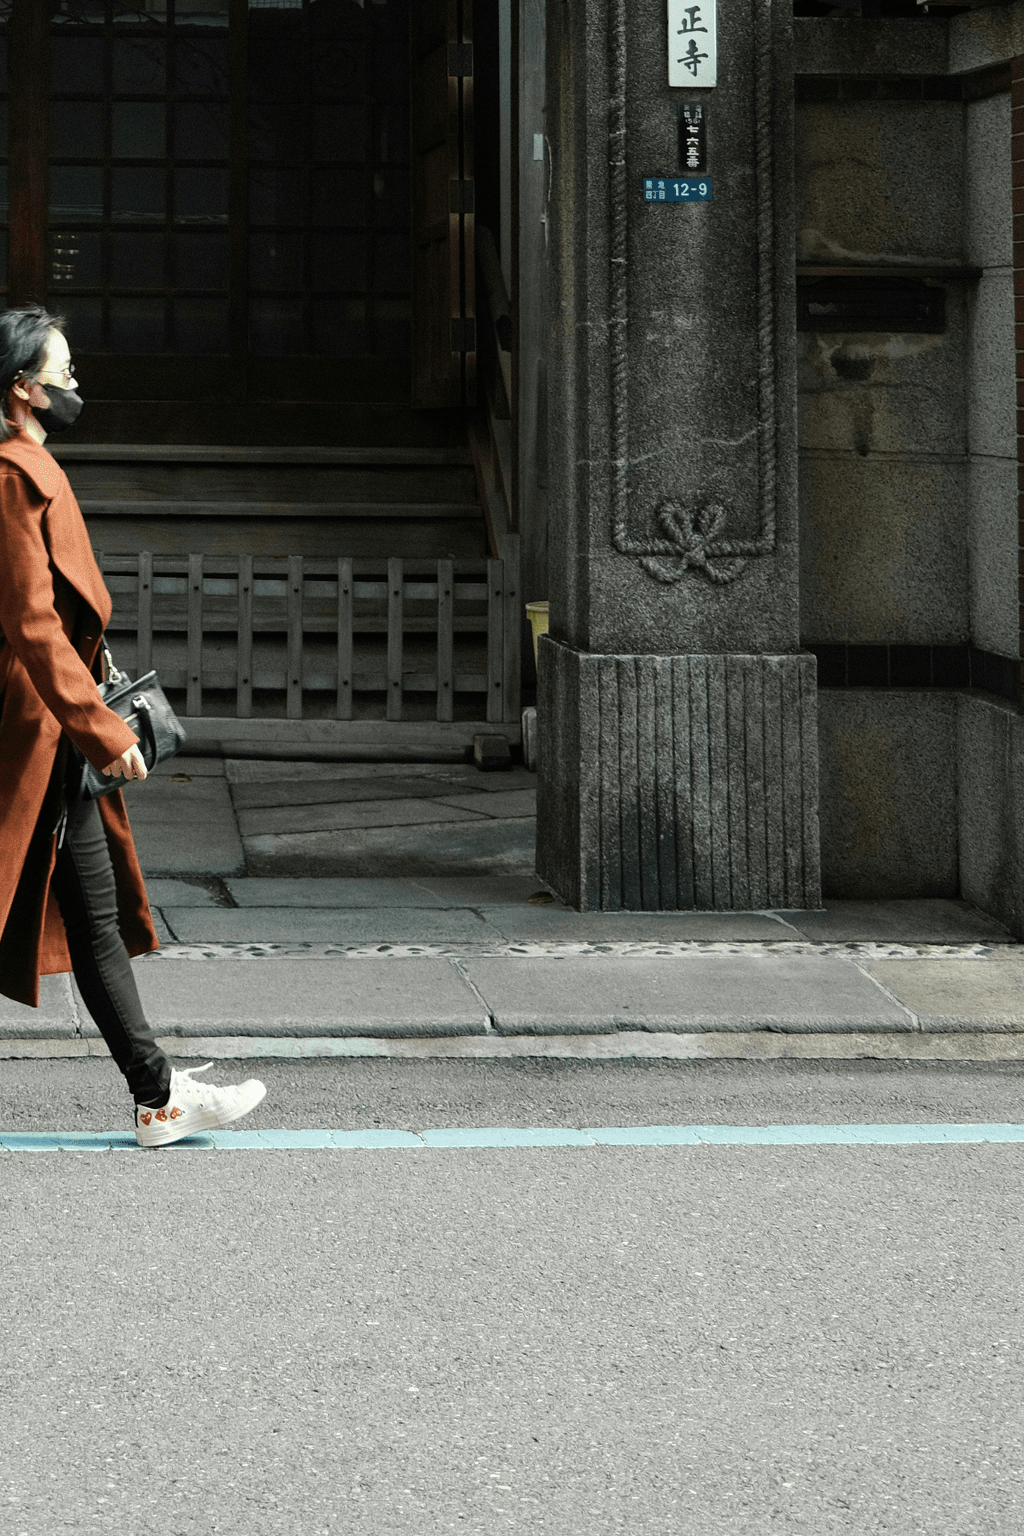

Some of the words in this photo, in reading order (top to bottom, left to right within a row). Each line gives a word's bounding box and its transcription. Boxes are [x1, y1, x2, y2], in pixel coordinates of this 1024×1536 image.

[686, 125, 700, 168] 七六五番
[673, 182, 707, 196] 12-9
